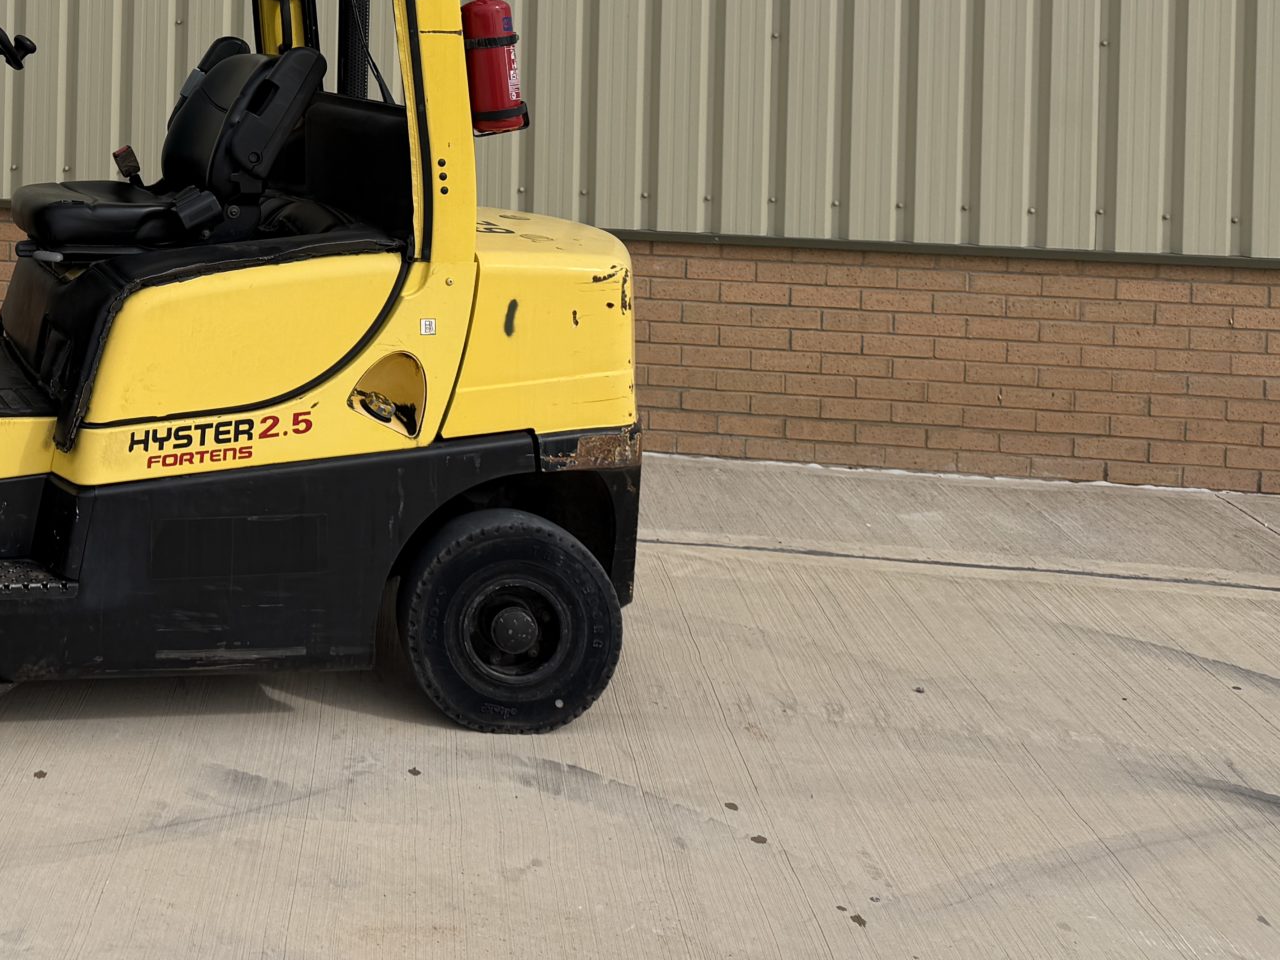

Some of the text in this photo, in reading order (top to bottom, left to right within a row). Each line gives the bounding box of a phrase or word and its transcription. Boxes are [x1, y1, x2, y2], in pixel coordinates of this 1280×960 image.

[128, 410, 314, 453] HYSTER 2.5
[146, 445, 254, 469] FORTENS
